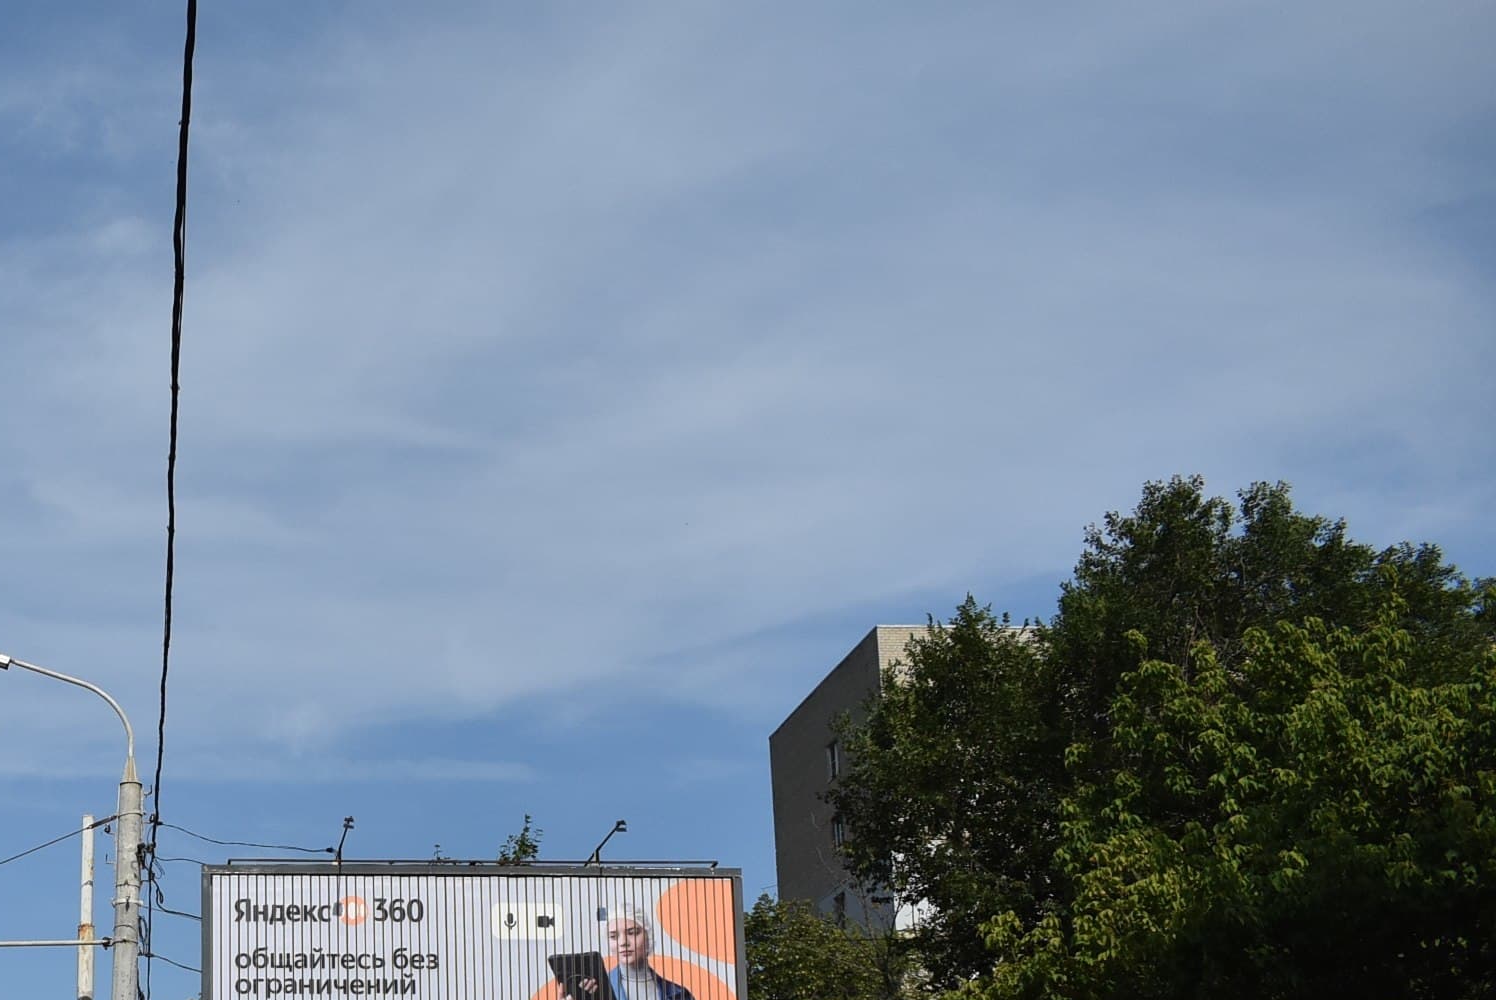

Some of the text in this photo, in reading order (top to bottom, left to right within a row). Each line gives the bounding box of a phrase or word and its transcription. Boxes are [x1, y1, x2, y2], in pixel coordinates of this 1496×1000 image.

[234, 898, 332, 926] Яндекс
[373, 897, 424, 923] 360
[234, 947, 440, 973] общайтесь без
[234, 972, 417, 999] ограничений
